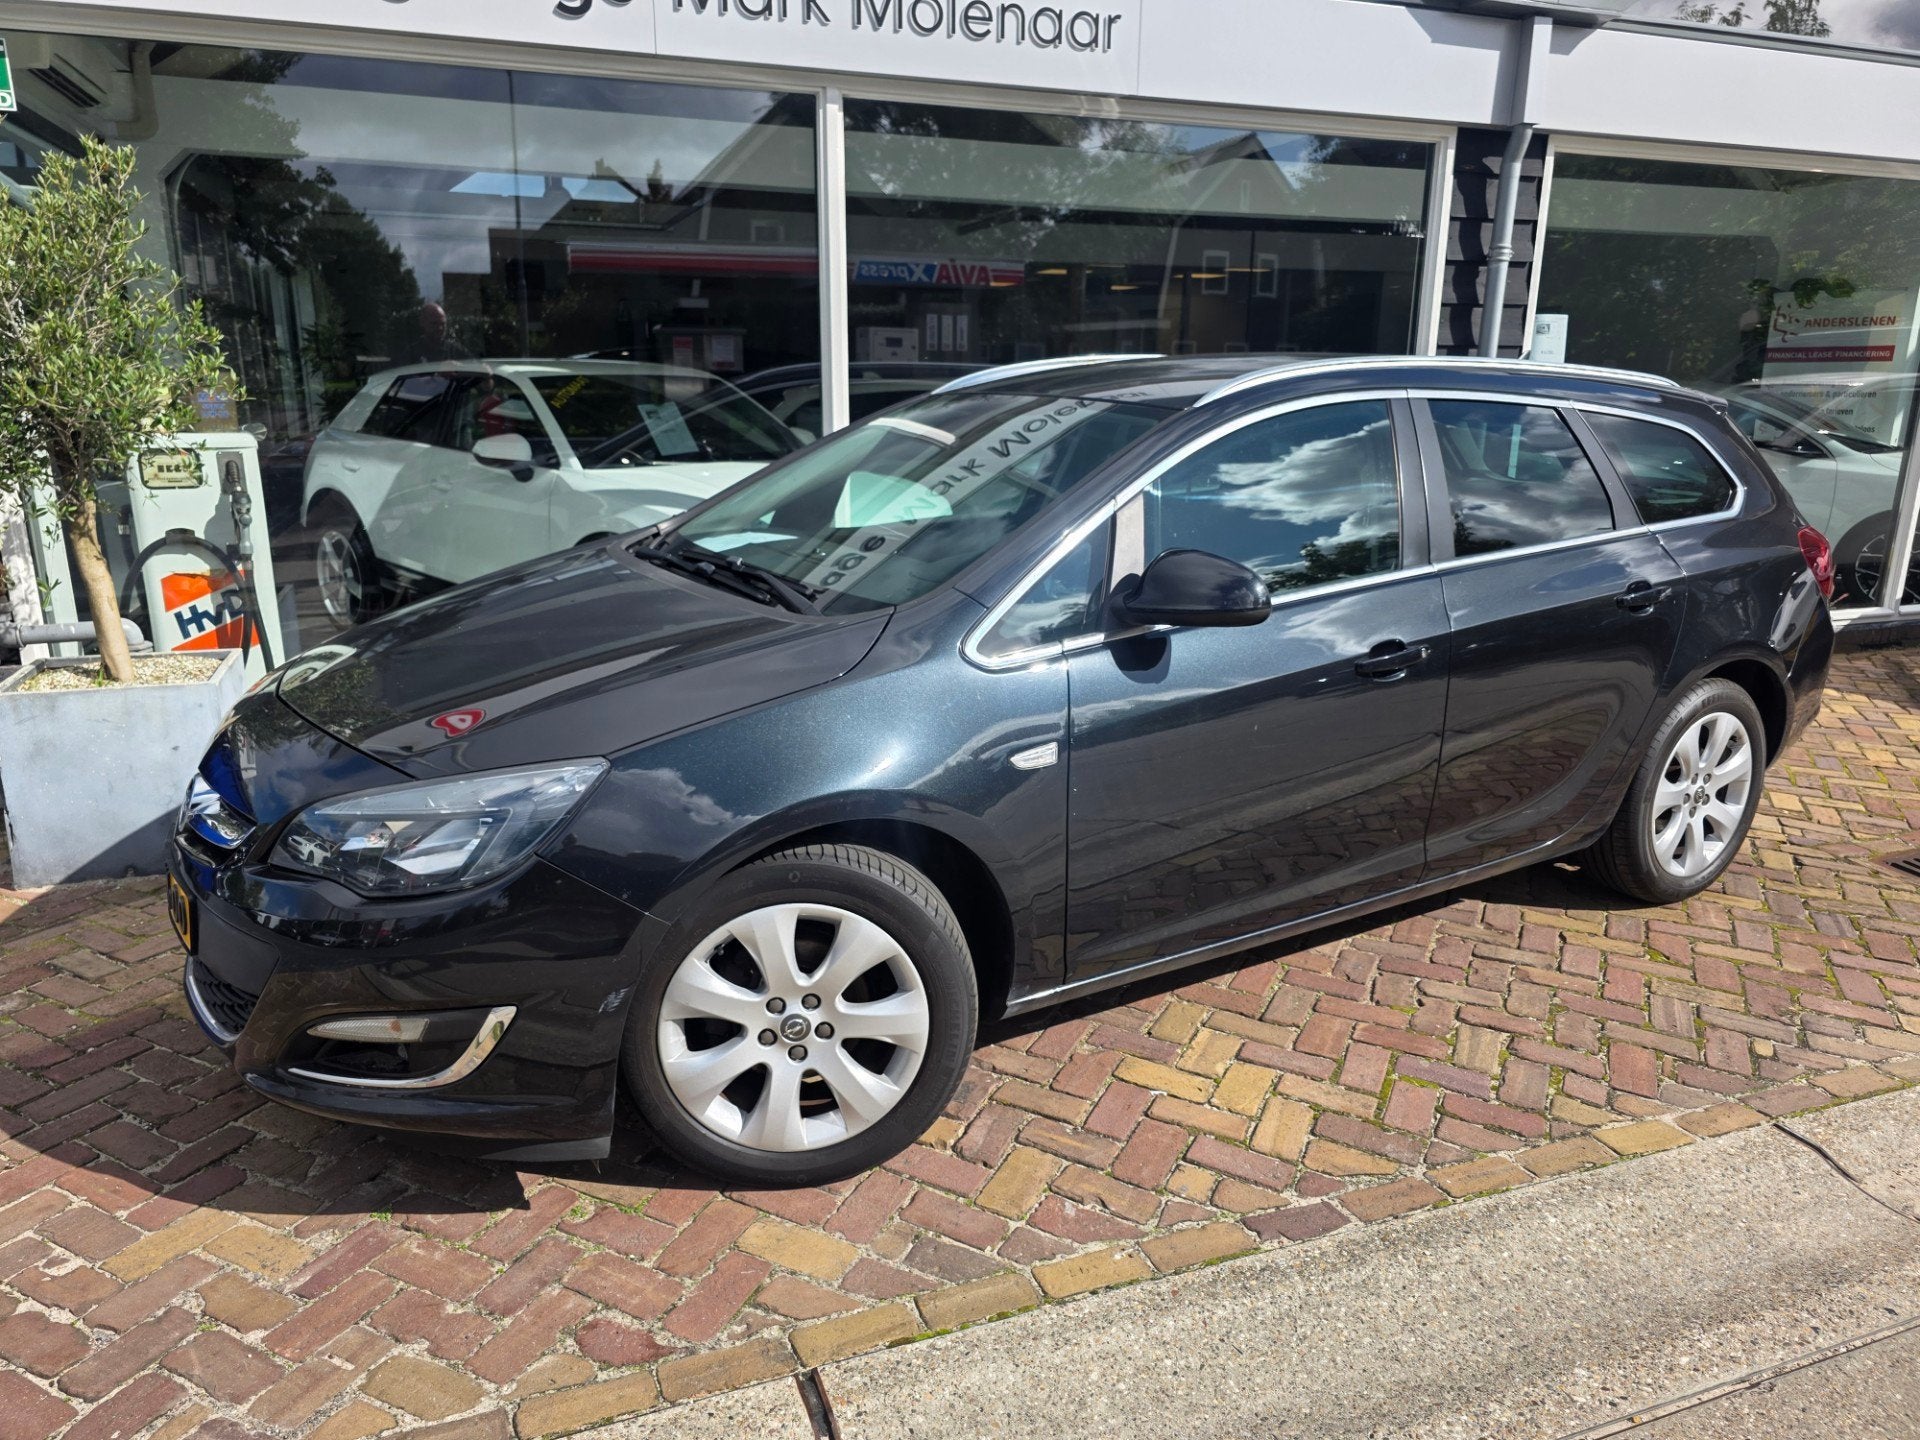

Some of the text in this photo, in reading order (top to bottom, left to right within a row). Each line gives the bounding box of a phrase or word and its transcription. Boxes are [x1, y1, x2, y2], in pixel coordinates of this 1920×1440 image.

[673, 0, 831, 25] ark
[852, 0, 1121, 51] Molenaar
[1804, 316, 1897, 328] ANDERSLENEN
[1835, 350, 1891, 358] FINANCIERING
